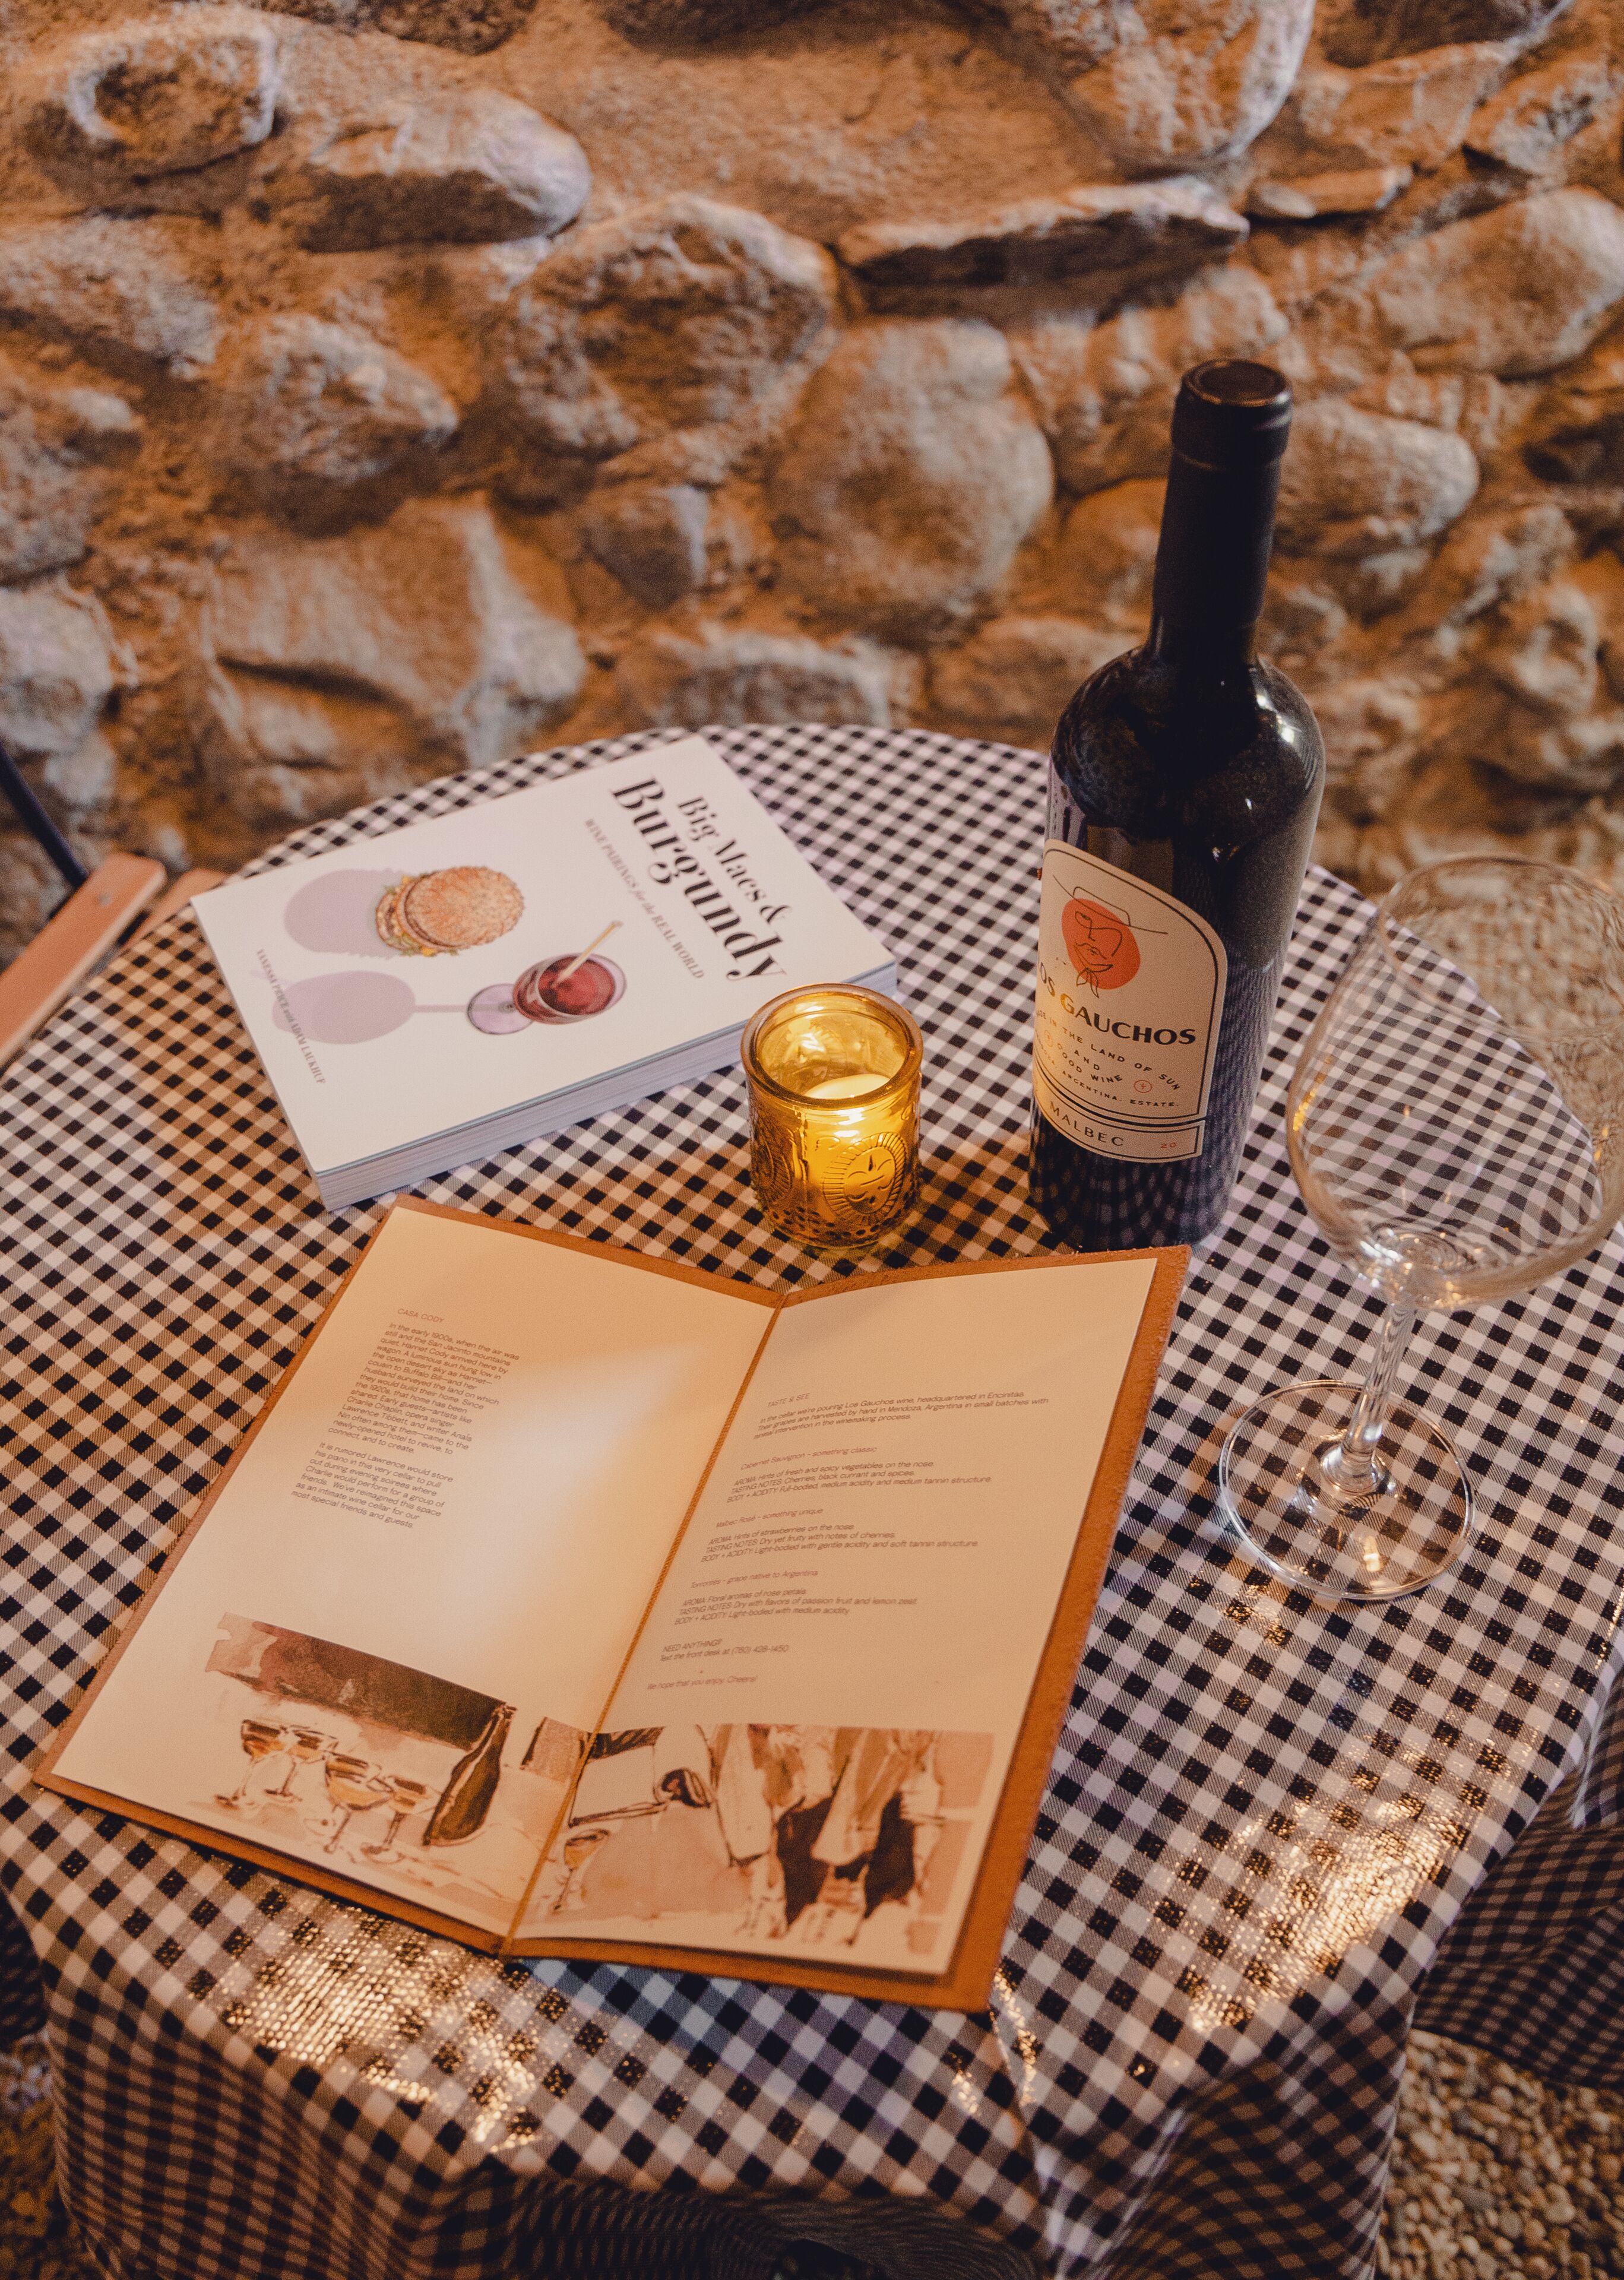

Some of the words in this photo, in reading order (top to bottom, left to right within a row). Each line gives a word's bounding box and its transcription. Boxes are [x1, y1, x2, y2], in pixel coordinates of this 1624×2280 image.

[678, 796, 720, 842] Big
[715, 840, 767, 902] Macs
[759, 905, 791, 924] &
[610, 778, 787, 981] Burgundy
[585, 818, 604, 844] WINE
[601, 844, 636, 888] PAIRINGS
[634, 888, 645, 901] for
[642, 901, 656, 914] the
[651, 916, 676, 943] REAL
[672, 941, 704, 979] WORLD
[1040, 962, 1055, 997] OS
[1060, 993, 1196, 1045] GAUCHOS
[1063, 1027, 1082, 1043] THE
[1091, 1044, 1125, 1062] LAND
[1134, 1063, 1152, 1072] OF
[1158, 1074, 1180, 1090] SUN
[1074, 1049, 1100, 1071] AND
[1090, 1074, 1123, 1084] WINE
[1049, 1100, 1124, 1147] MALBEC
[397, 1307, 419, 1317] CASA
[420, 1313, 444, 1323] CODY
[411, 1329, 429, 1337] early
[401, 1342, 428, 1352] Harriet
[428, 1348, 448, 1358] Cody
[450, 1356, 477, 1365] arrived
[478, 1361, 496, 1370] here
[406, 1359, 431, 1369] desert
[444, 1344, 471, 1355] Jacinto
[473, 1353, 511, 1365] mountains
[368, 1359, 392, 1368] cousin
[403, 1367, 429, 1378] Buffalo
[458, 1364, 477, 1375] hung
[360, 1373, 376, 1382] they
[378, 1379, 399, 1387] would
[400, 1383, 418, 1392] build
[419, 1388, 436, 1396] their
[462, 1399, 484, 1408] Since
[363, 1366, 395, 1378] husband
[397, 1375, 431, 1387] surveyed
[447, 1387, 464, 1395] land
[476, 1396, 500, 1404] which
[380, 1395, 398, 1405] Early
[410, 1394, 430, 1404] home
[447, 1404, 467, 1413] been
[767, 1398, 786, 1407] TASTE
[796, 1393, 810, 1401] SEE
[816, 1404, 843, 1413] pouring
[860, 1398, 894, 1406] Gauchos
[917, 1392, 977, 1401] headquartered
[342, 1403, 379, 1417] Lawrence
[426, 1426, 448, 1434] writer
[346, 1395, 373, 1406] Charlie
[405, 1411, 428, 1420] opera
[430, 1418, 454, 1427] singer
[811, 1410, 847, 1420] harvested
[925, 1402, 963, 1410] Argentina
[835, 1416, 876, 1424] winemaking
[373, 1421, 397, 1431] among
[387, 1432, 407, 1441] hotel
[327, 1454, 348, 1462] piano
[374, 1467, 391, 1475] very
[393, 1471, 414, 1480] cellar
[334, 1447, 366, 1458] rumored
[367, 1455, 405, 1468] Lawrence
[407, 1466, 430, 1475] would
[431, 1472, 454, 1481] store
[741, 1458, 770, 1469] Cabernet
[771, 1453, 805, 1462] Sauvignon
[812, 1448, 849, 1456] something
[841, 1462, 883, 1471] vegetables
[305, 1465, 332, 1477] Charlie
[334, 1474, 356, 1483] would
[357, 1481, 388, 1492] perform
[409, 1495, 433, 1505] group
[324, 1461, 347, 1472] during
[349, 1470, 378, 1481] evening
[411, 1486, 437, 1496] where
[311, 1496, 338, 1506] special
[340, 1503, 367, 1515] friends
[318, 1488, 346, 1499] intimate
[368, 1502, 390, 1511] cellar
[356, 1490, 398, 1504] reimagined
[416, 1506, 441, 1516] space
[762, 1510, 797, 1519] something
[760, 1526, 805, 1535] strawberries
[755, 1543, 799, 1553] Light-bodied
